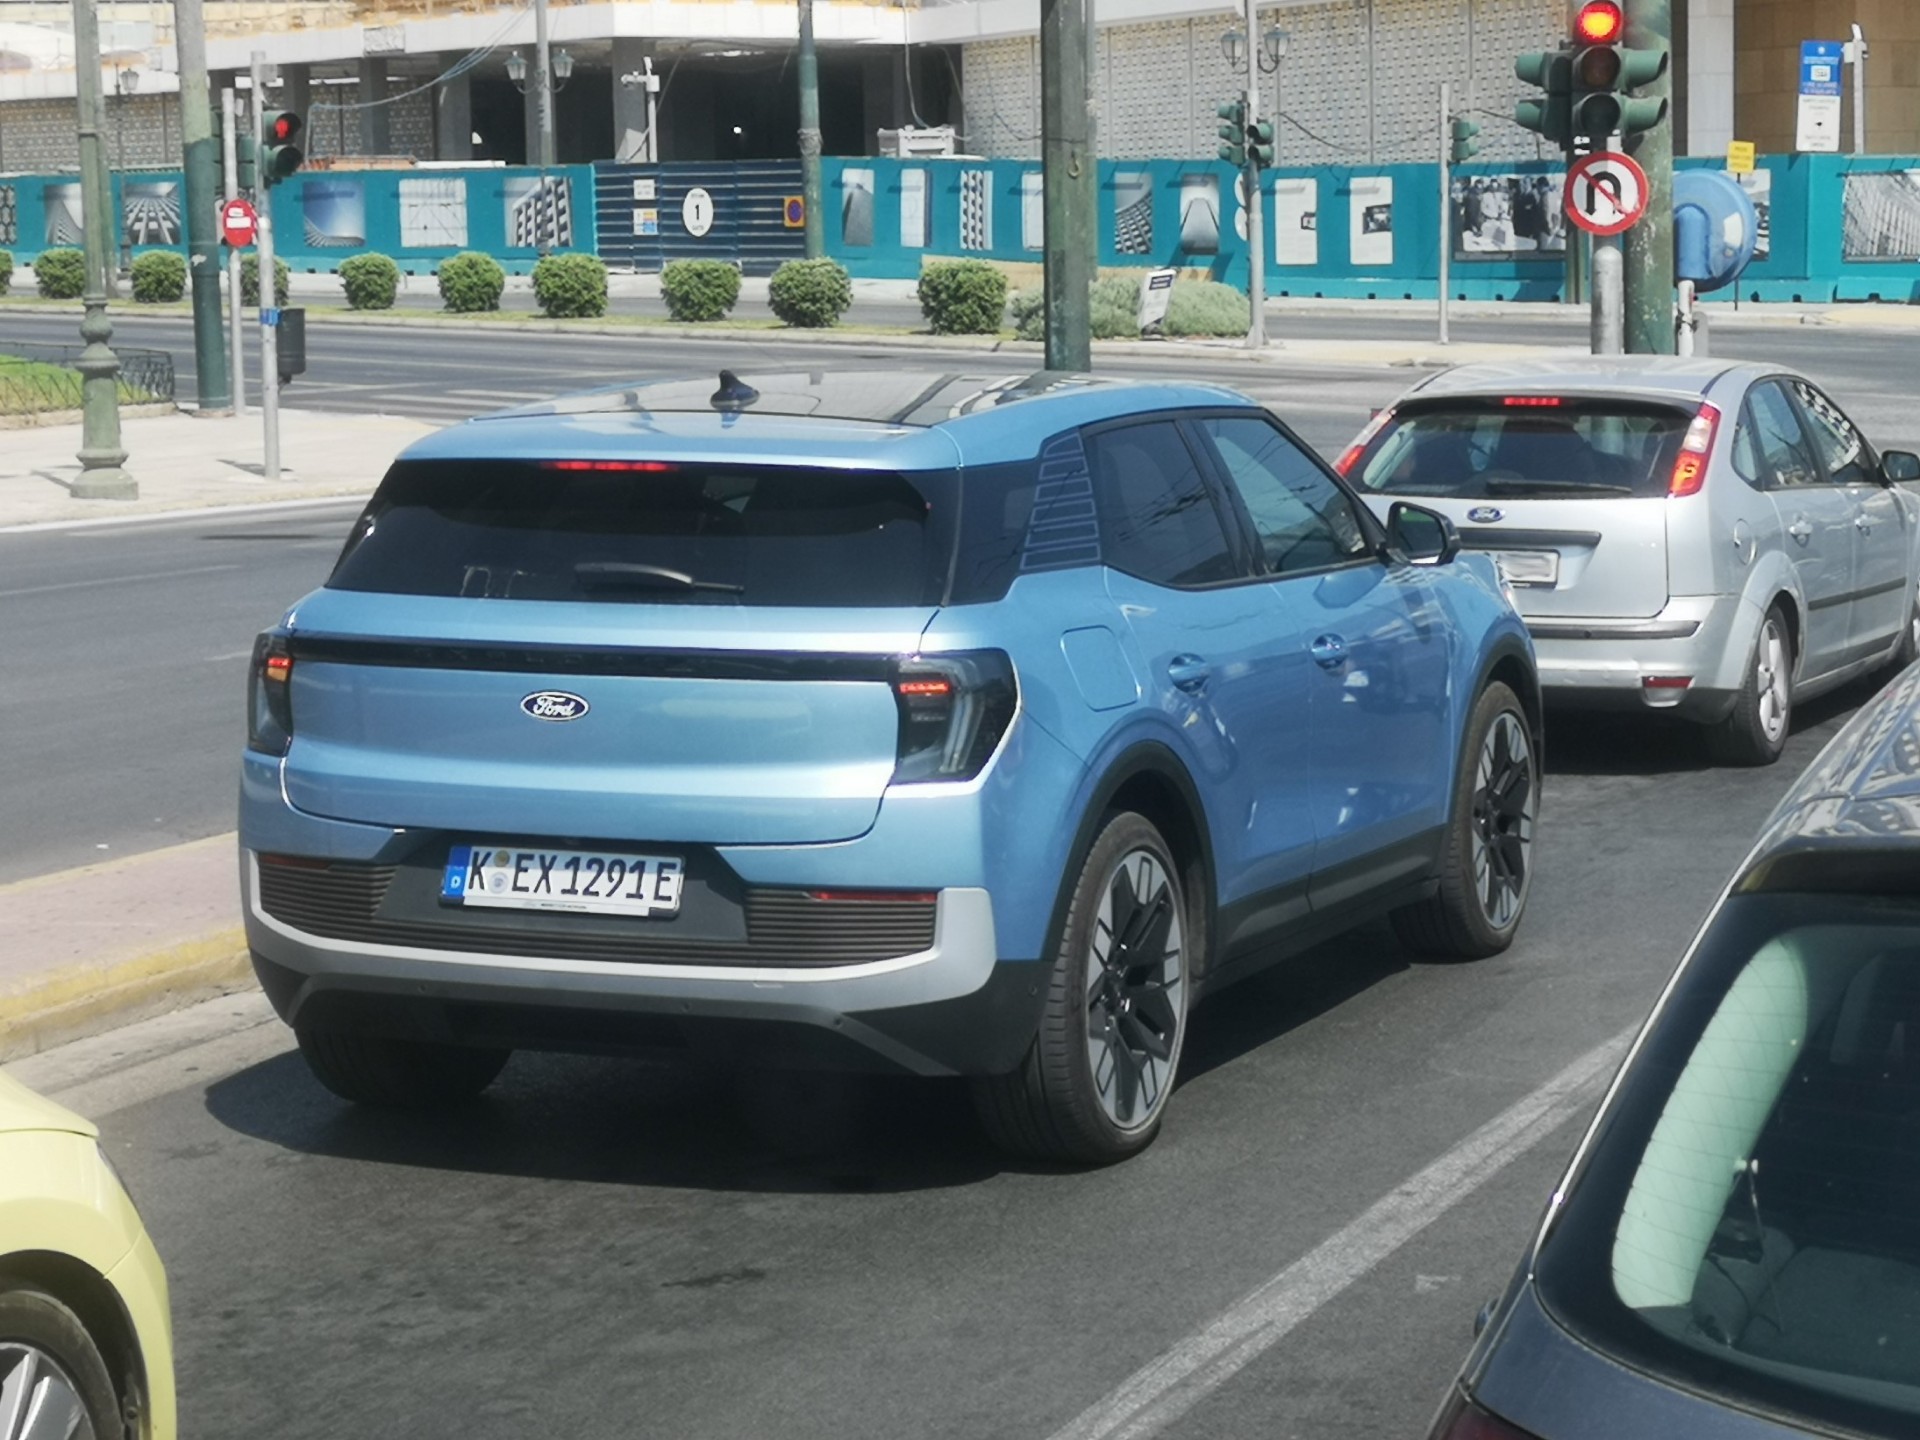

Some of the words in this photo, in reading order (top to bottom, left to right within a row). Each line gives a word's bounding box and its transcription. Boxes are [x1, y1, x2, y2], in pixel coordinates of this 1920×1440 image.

[694, 204, 700, 221] 1
[532, 694, 576, 716] Ford
[468, 851, 492, 890] K
